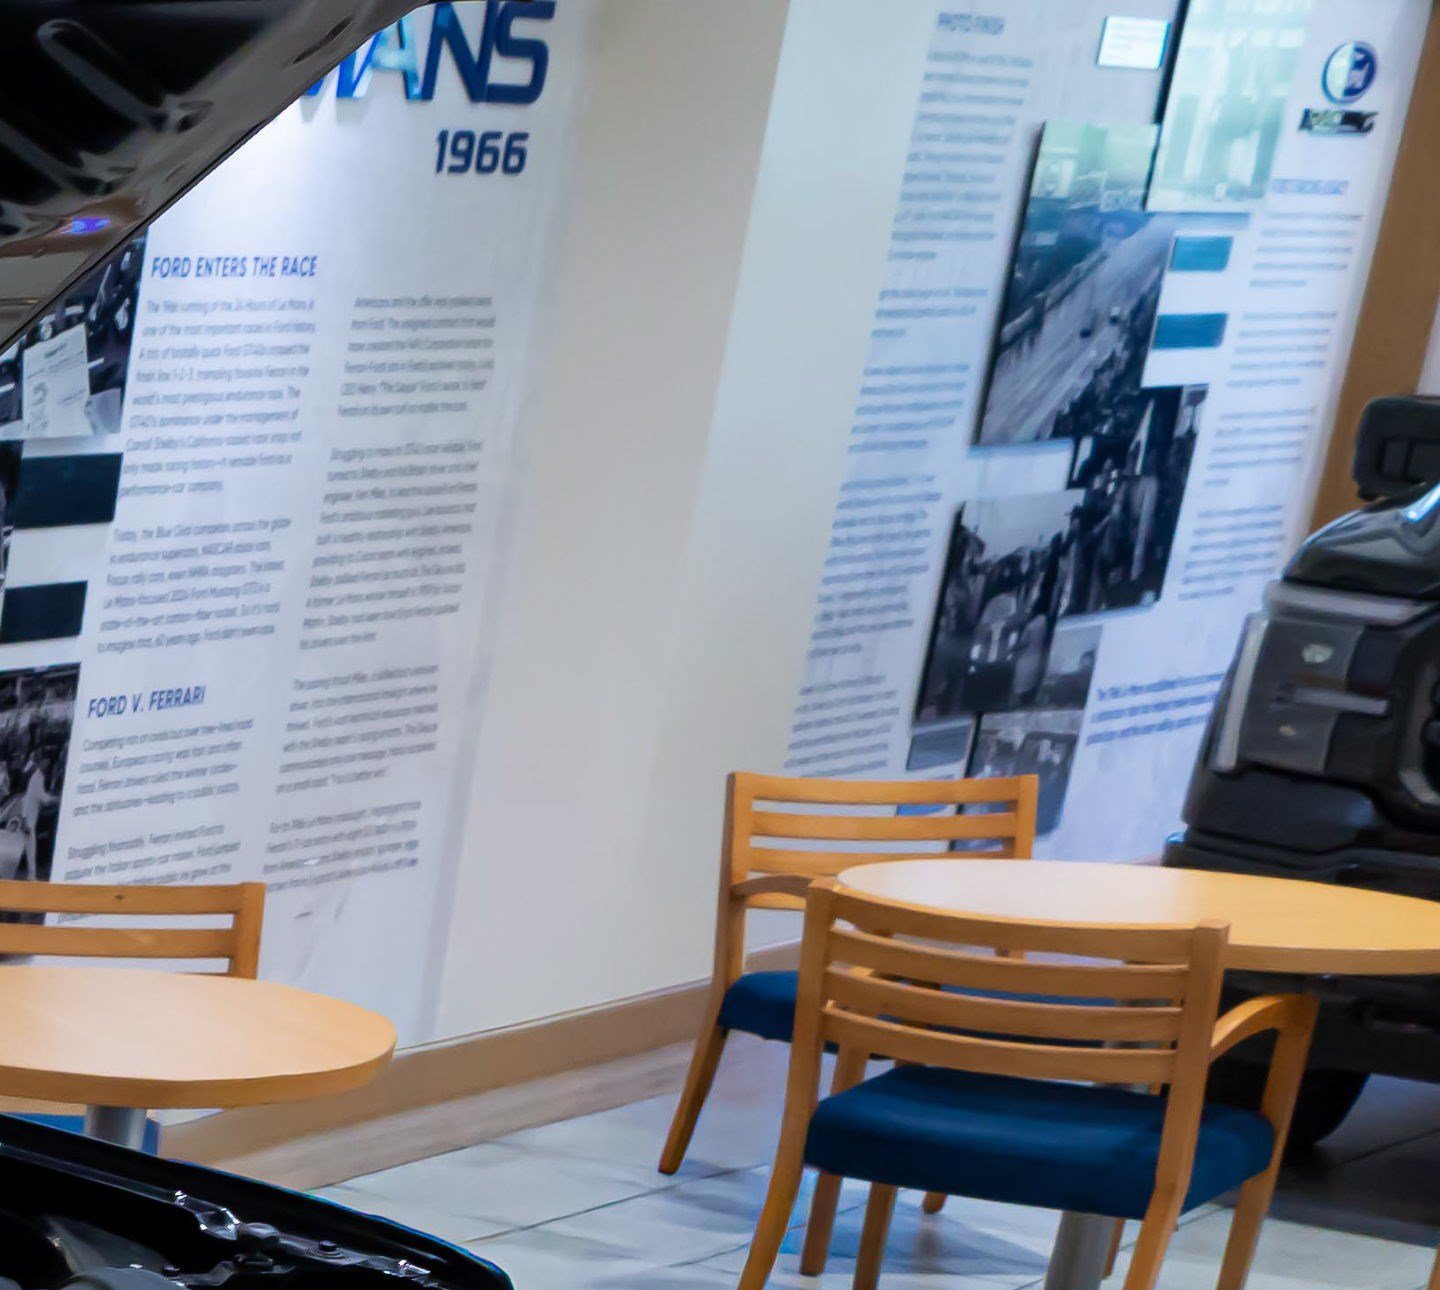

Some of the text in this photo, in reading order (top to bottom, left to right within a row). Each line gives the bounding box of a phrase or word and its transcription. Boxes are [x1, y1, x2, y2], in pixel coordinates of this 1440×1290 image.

[436, 129, 530, 175] 1966
[151, 255, 318, 278] FORD ENTERS THE RACE
[87, 685, 206, 718] FORD V. FERRARI
